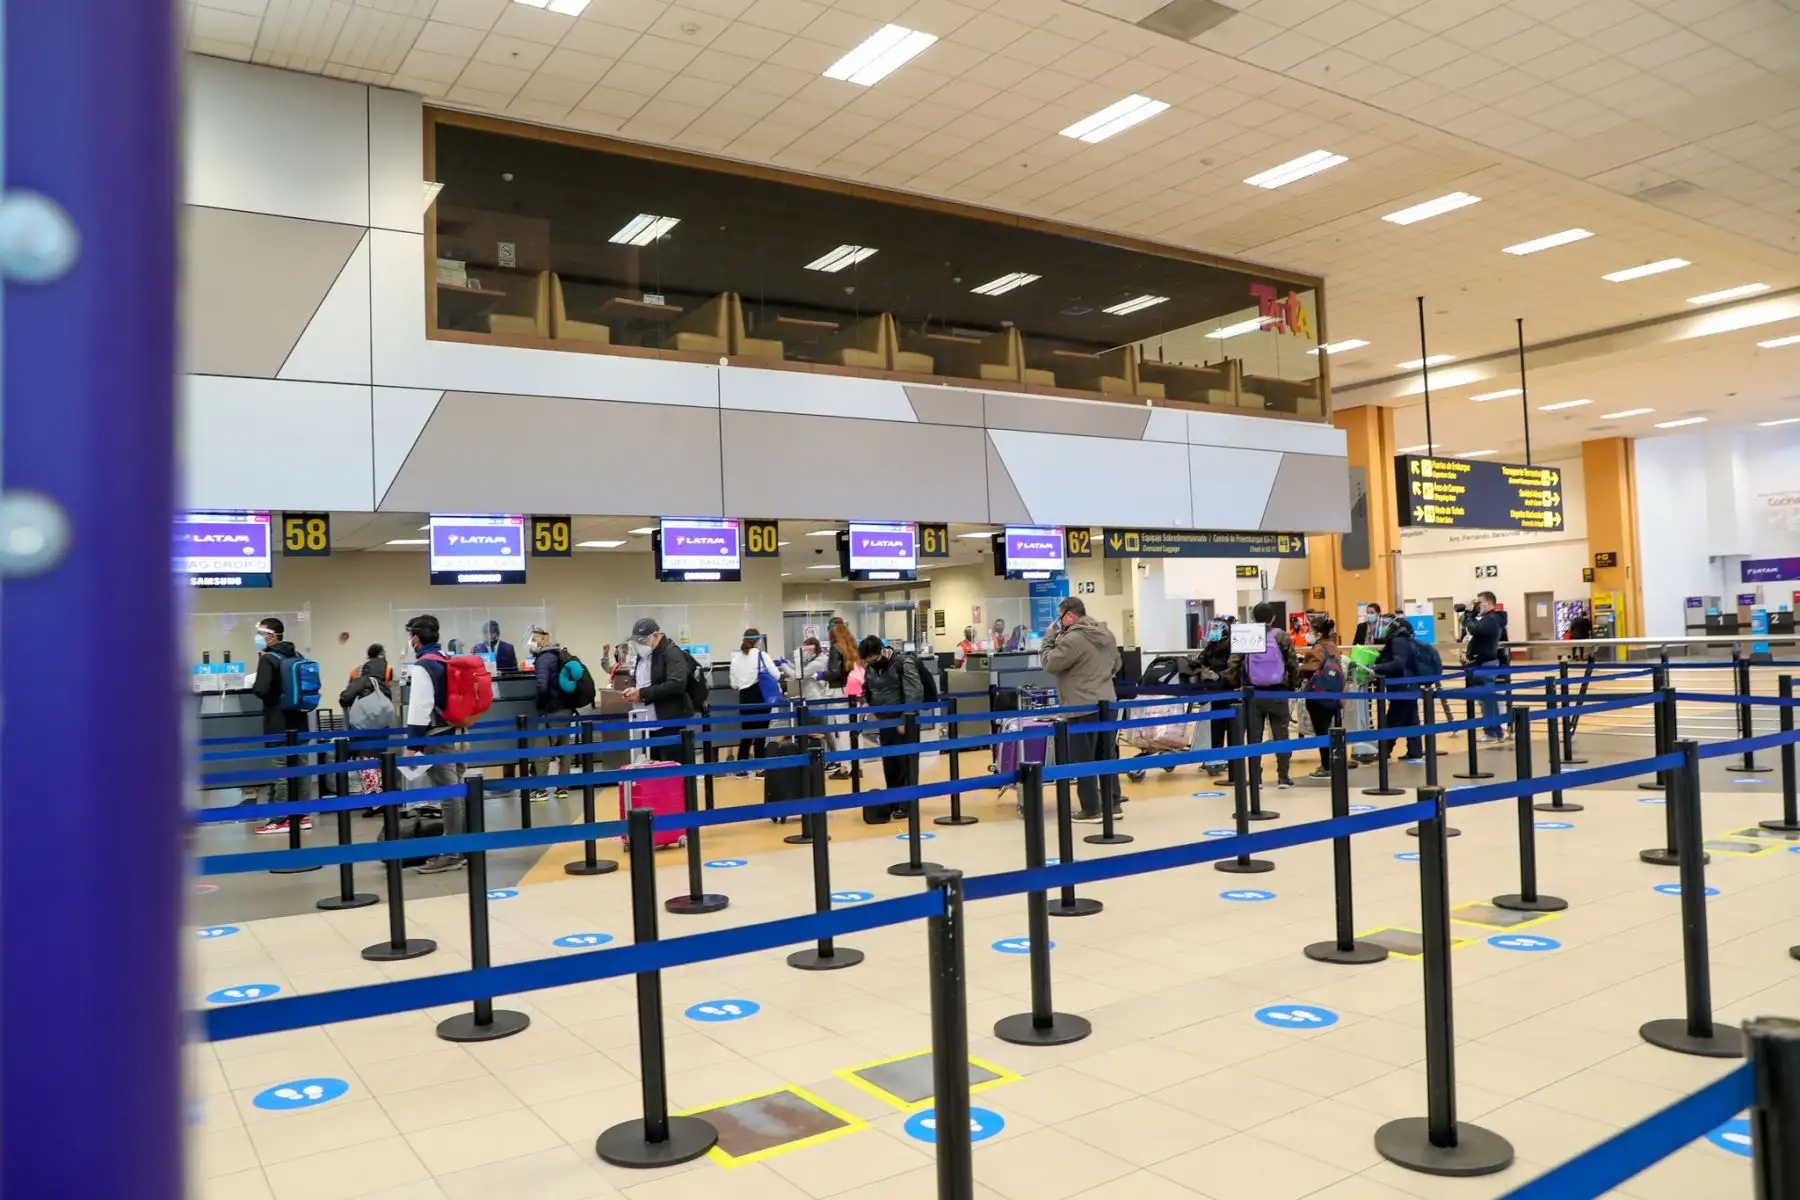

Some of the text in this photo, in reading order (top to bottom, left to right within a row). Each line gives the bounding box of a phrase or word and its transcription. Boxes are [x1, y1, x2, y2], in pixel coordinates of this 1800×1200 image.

[193, 534, 250, 543] LATAM
[286, 518, 328, 551] 58
[460, 535, 507, 544] LATAM
[535, 522, 569, 552] 59
[748, 525, 777, 553] 60
[686, 537, 725, 545] LATAM
[870, 539, 904, 547] LATAM
[924, 527, 946, 553] 61
[1069, 530, 1090, 553] 62
[190, 576, 242, 586] SAMSUNG
[1717, 615, 1724, 625] 1
[1771, 614, 1780, 624] 2
